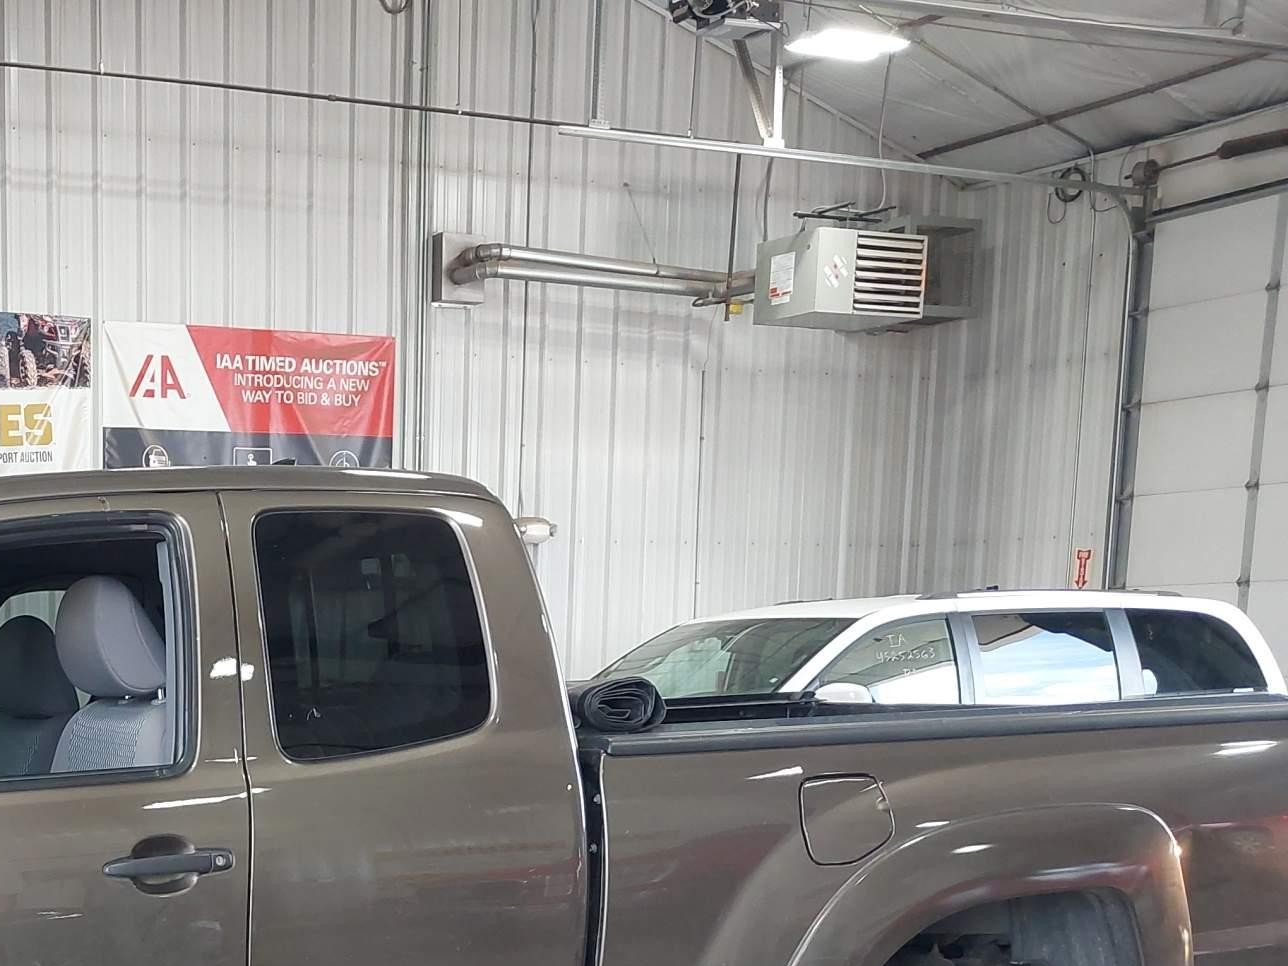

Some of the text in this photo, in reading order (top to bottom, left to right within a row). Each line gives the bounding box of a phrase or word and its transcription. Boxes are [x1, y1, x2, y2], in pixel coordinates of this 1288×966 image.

[216, 353, 243, 370] IAA
[244, 355, 296, 372] TIMED
[234, 373, 370, 391] INTRODUCING A NEW
[242, 390, 362, 407] WAY TO BID & BUY
[20, 451, 53, 464] AUCTION
